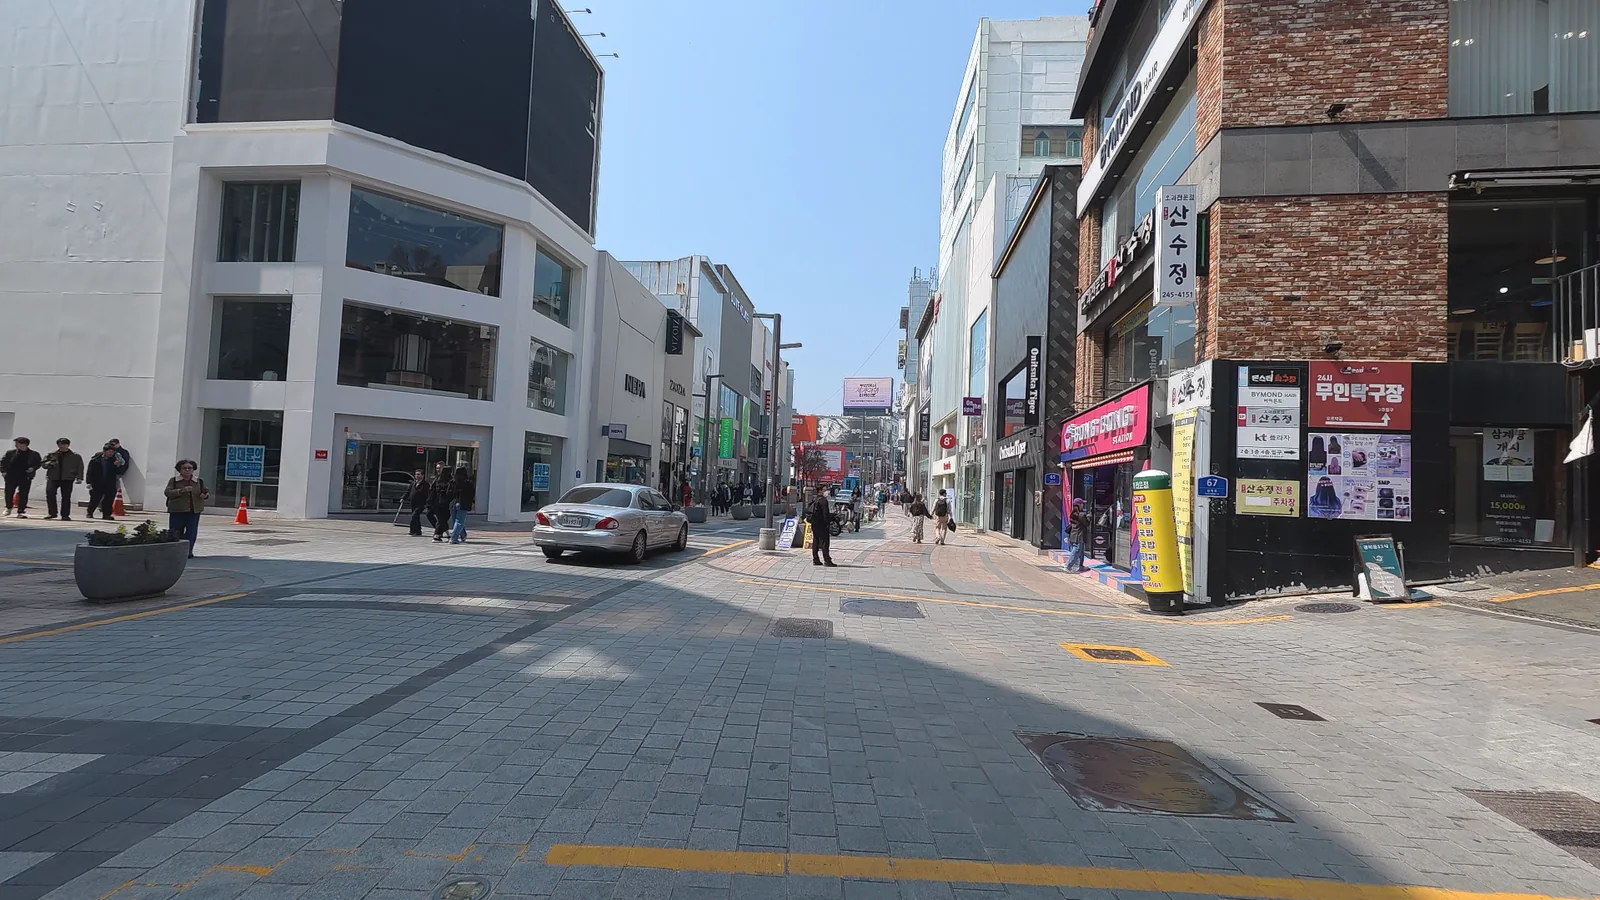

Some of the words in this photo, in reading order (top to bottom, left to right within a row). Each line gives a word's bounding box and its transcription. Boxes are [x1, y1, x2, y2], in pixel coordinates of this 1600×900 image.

[1100, 81, 1142, 169] BYMOND
[1143, 61, 1158, 94] HAIR
[1169, 205, 1189, 285] 산수정
[1030, 347, 1040, 389] Onitsuka
[625, 373, 646, 399] NEPA
[1178, 375, 1205, 405] 산수정
[1315, 382, 1405, 403] 무인탁구장
[1028, 390, 1038, 415] Tiger
[1259, 414, 1292, 424] 산수정
[1255, 433, 1267, 441] kt
[228, 446, 263, 461] 임대문의
[1206, 479, 1218, 487] 67
[1246, 484, 1274, 494] 산수정
[1273, 497, 1296, 507] 주차장
